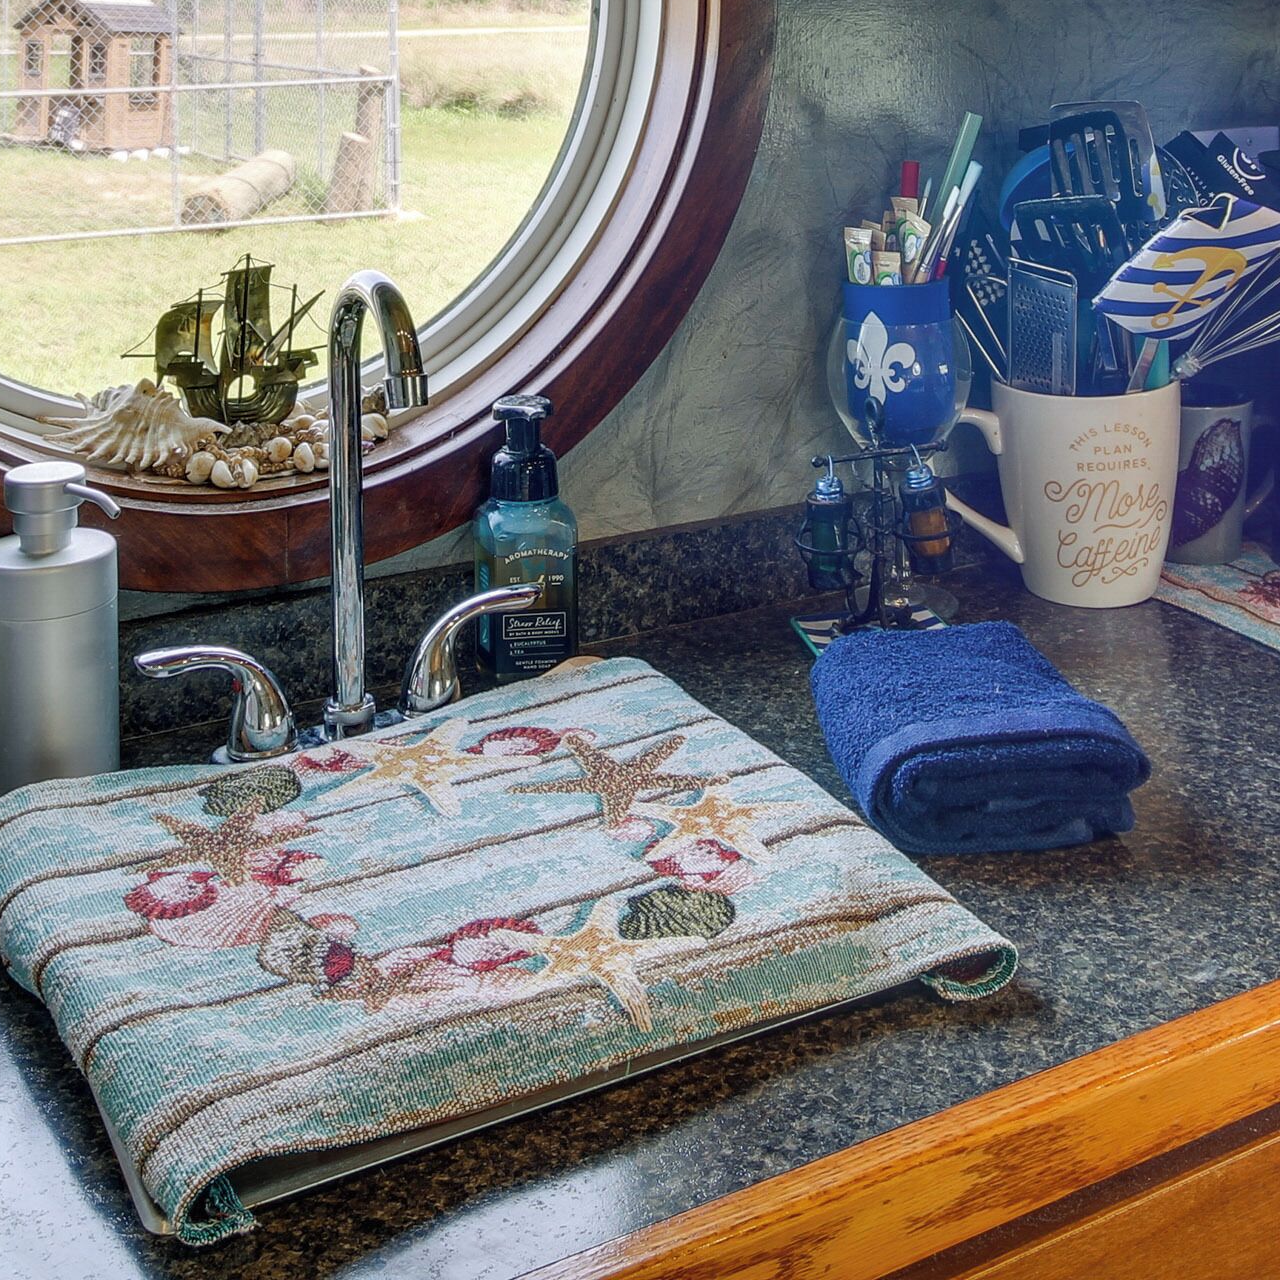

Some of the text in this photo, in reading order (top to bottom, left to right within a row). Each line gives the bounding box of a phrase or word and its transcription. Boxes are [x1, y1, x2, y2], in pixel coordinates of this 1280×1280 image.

[1216, 154, 1255, 196] Gluten-Free
[1069, 423, 1153, 452] THIS LESSON
[1094, 444, 1133, 456] PLAN
[1050, 478, 1168, 524] More
[504, 548, 569, 565] AROMATHERAPY
[1057, 526, 1162, 587] Caffeine
[548, 574, 565, 582] 1990
